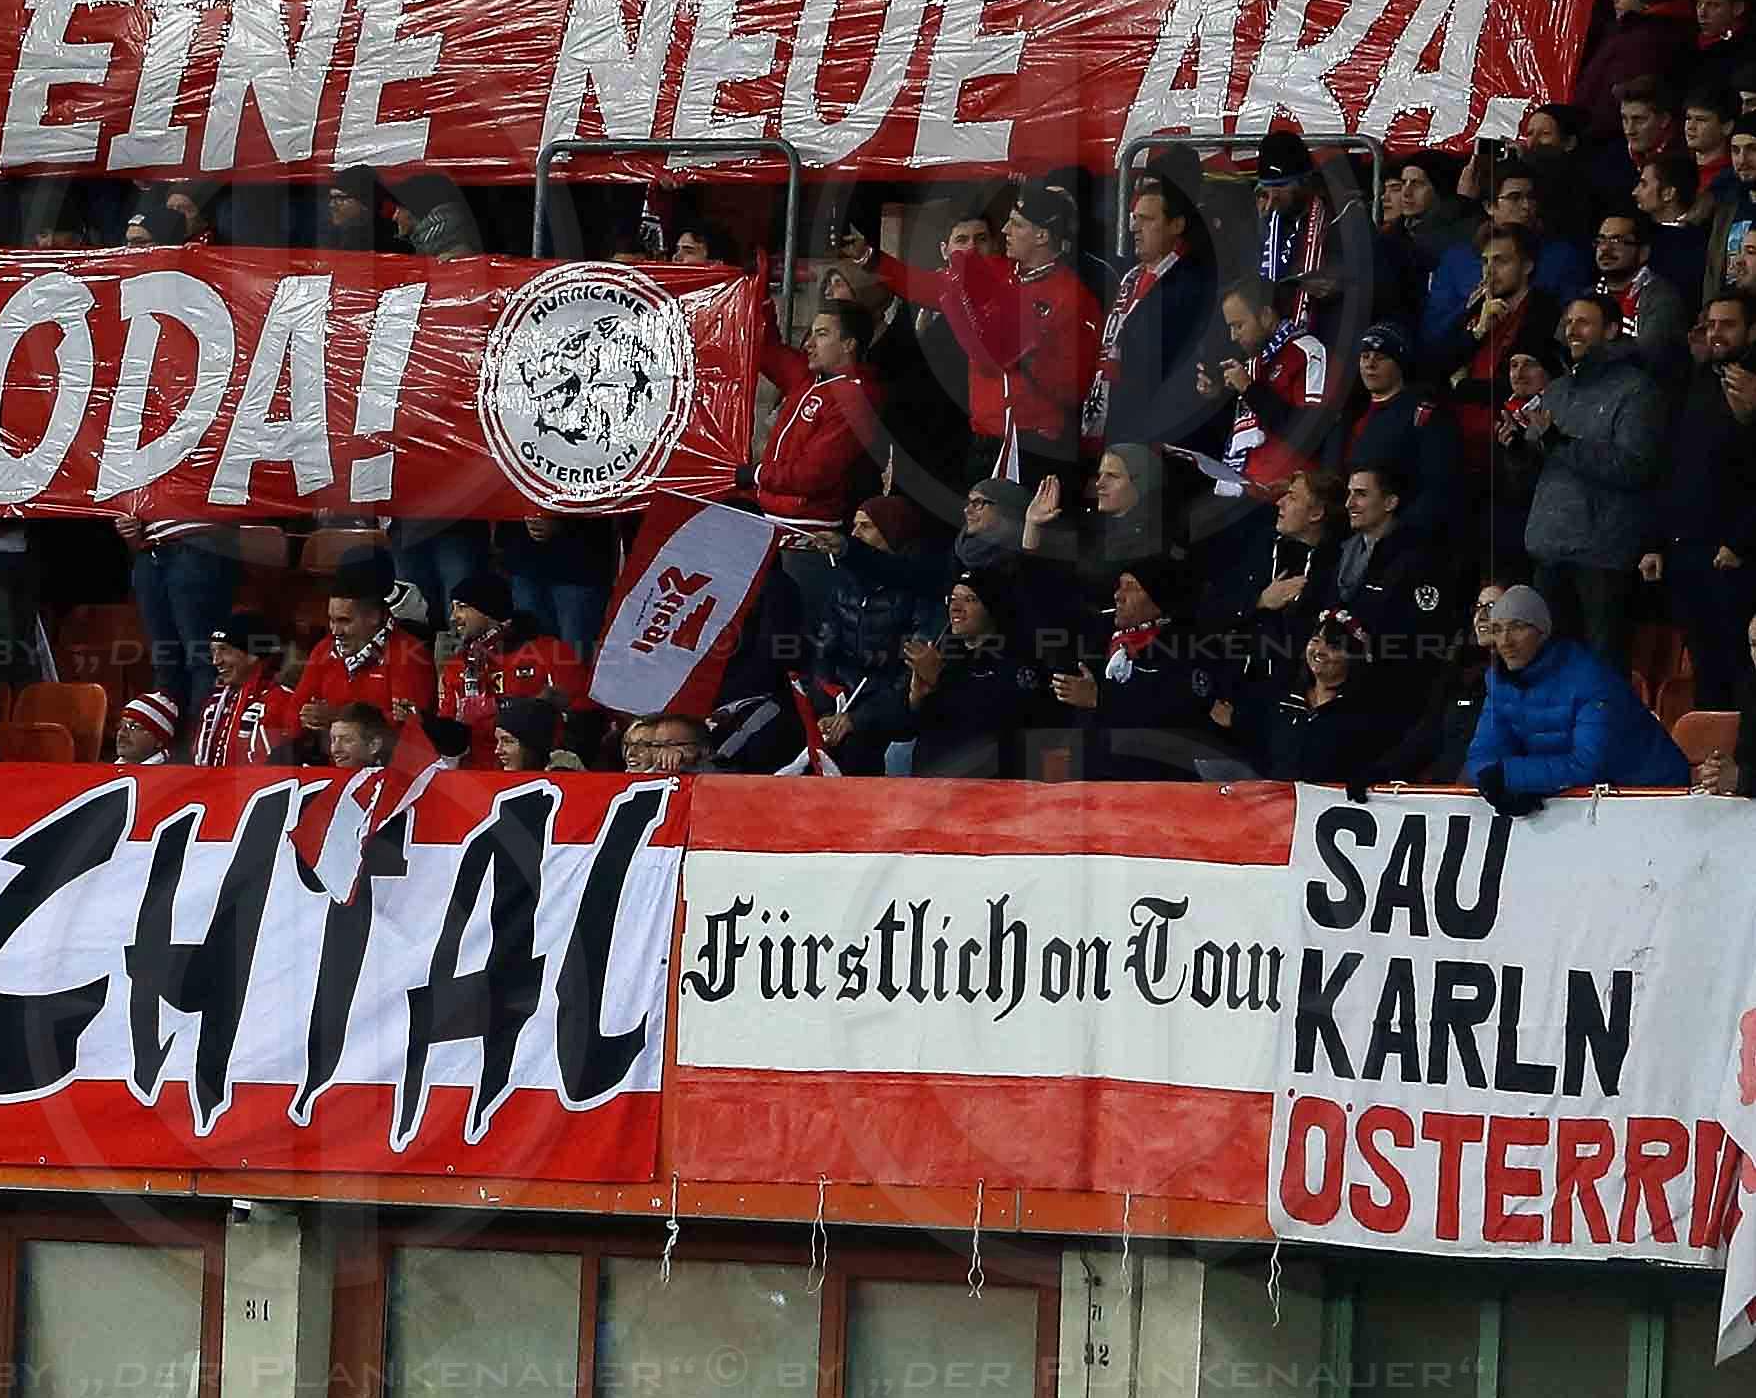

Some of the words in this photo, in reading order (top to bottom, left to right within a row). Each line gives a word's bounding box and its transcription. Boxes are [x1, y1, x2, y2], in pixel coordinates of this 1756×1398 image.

[531, 285, 651, 324] HURRICANE
[520, 440, 639, 484] ÖSTERREICH
[1304, 804, 1512, 941] SAU
[680, 892, 1027, 1024] Fürstlich
[1039, 934, 1111, 1005] on
[1292, 947, 1634, 1100] KARLN
[1278, 1087, 1740, 1252] ÖSTERR
